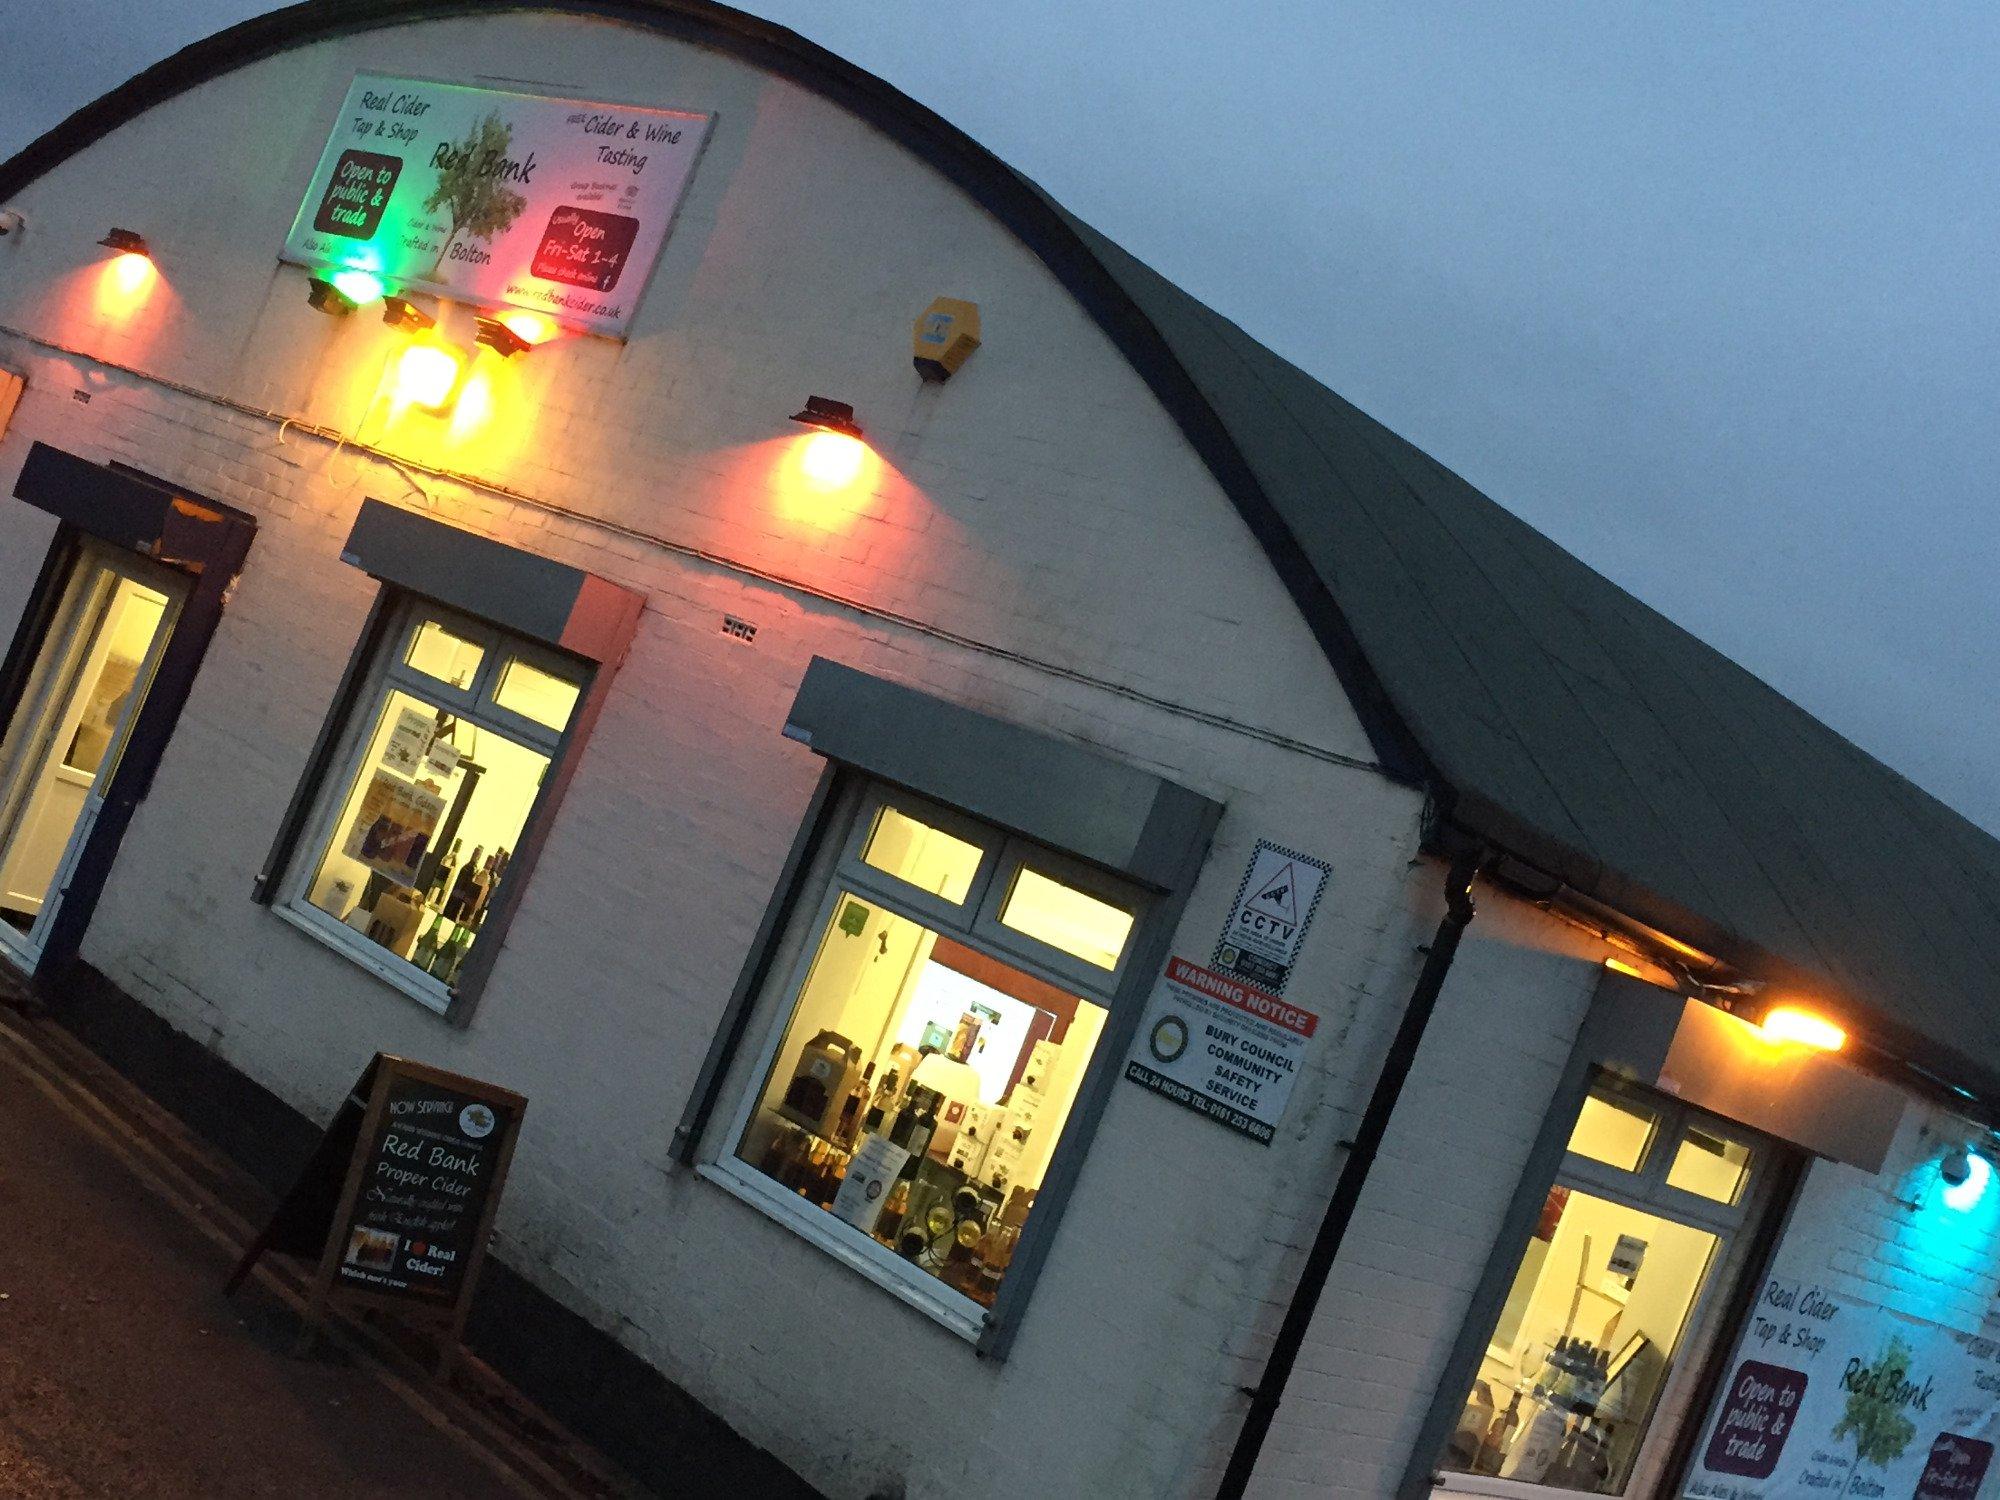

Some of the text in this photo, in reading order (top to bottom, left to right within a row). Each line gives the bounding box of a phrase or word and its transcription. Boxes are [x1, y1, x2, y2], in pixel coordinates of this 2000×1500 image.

[360, 91, 431, 116] Real Cider
[352, 117, 419, 147] Tap & Shop
[585, 114, 624, 136] Cider
[626, 120, 638, 138] &
[645, 124, 682, 144] Wine
[340, 160, 393, 185] Open to
[429, 141, 536, 184] Red Bank
[597, 145, 648, 175] Tasting
[327, 181, 385, 208] public &
[330, 204, 368, 227] trade
[573, 221, 606, 243] Open
[450, 242, 490, 266] Bolton
[543, 239, 619, 268] Fri-Sat 1-4
[1240, 910, 1296, 940] CCTV
[1174, 962, 1244, 1004] WARNING
[1246, 993, 1309, 1031] NOTICE
[1205, 1024, 1296, 1074] BURY COUNCIL
[1207, 1043, 1283, 1084] COMMUNITY
[1129, 1065, 1149, 1083] CALL
[1149, 1074, 1161, 1088] 24
[1160, 1078, 1191, 1101] HOURS
[1214, 1065, 1262, 1094] SAFETY
[1205, 1080, 1259, 1111] SERVICE
[382, 1133, 424, 1161] Red
[428, 1145, 480, 1176] Bank
[375, 1161, 471, 1197] Proper Cider
[404, 1239, 456, 1261] I Real
[406, 1257, 446, 1277] Cider!
[1763, 1280, 1840, 1321] Real Cider
[1753, 1316, 1827, 1360] Tap & Shop
[1738, 1375, 1797, 1408] Open to
[1839, 1356, 1884, 1397] Red
[1882, 1368, 1934, 1411] Bank
[1721, 1403, 1787, 1436] public &
[1725, 1434, 1768, 1461] trade
